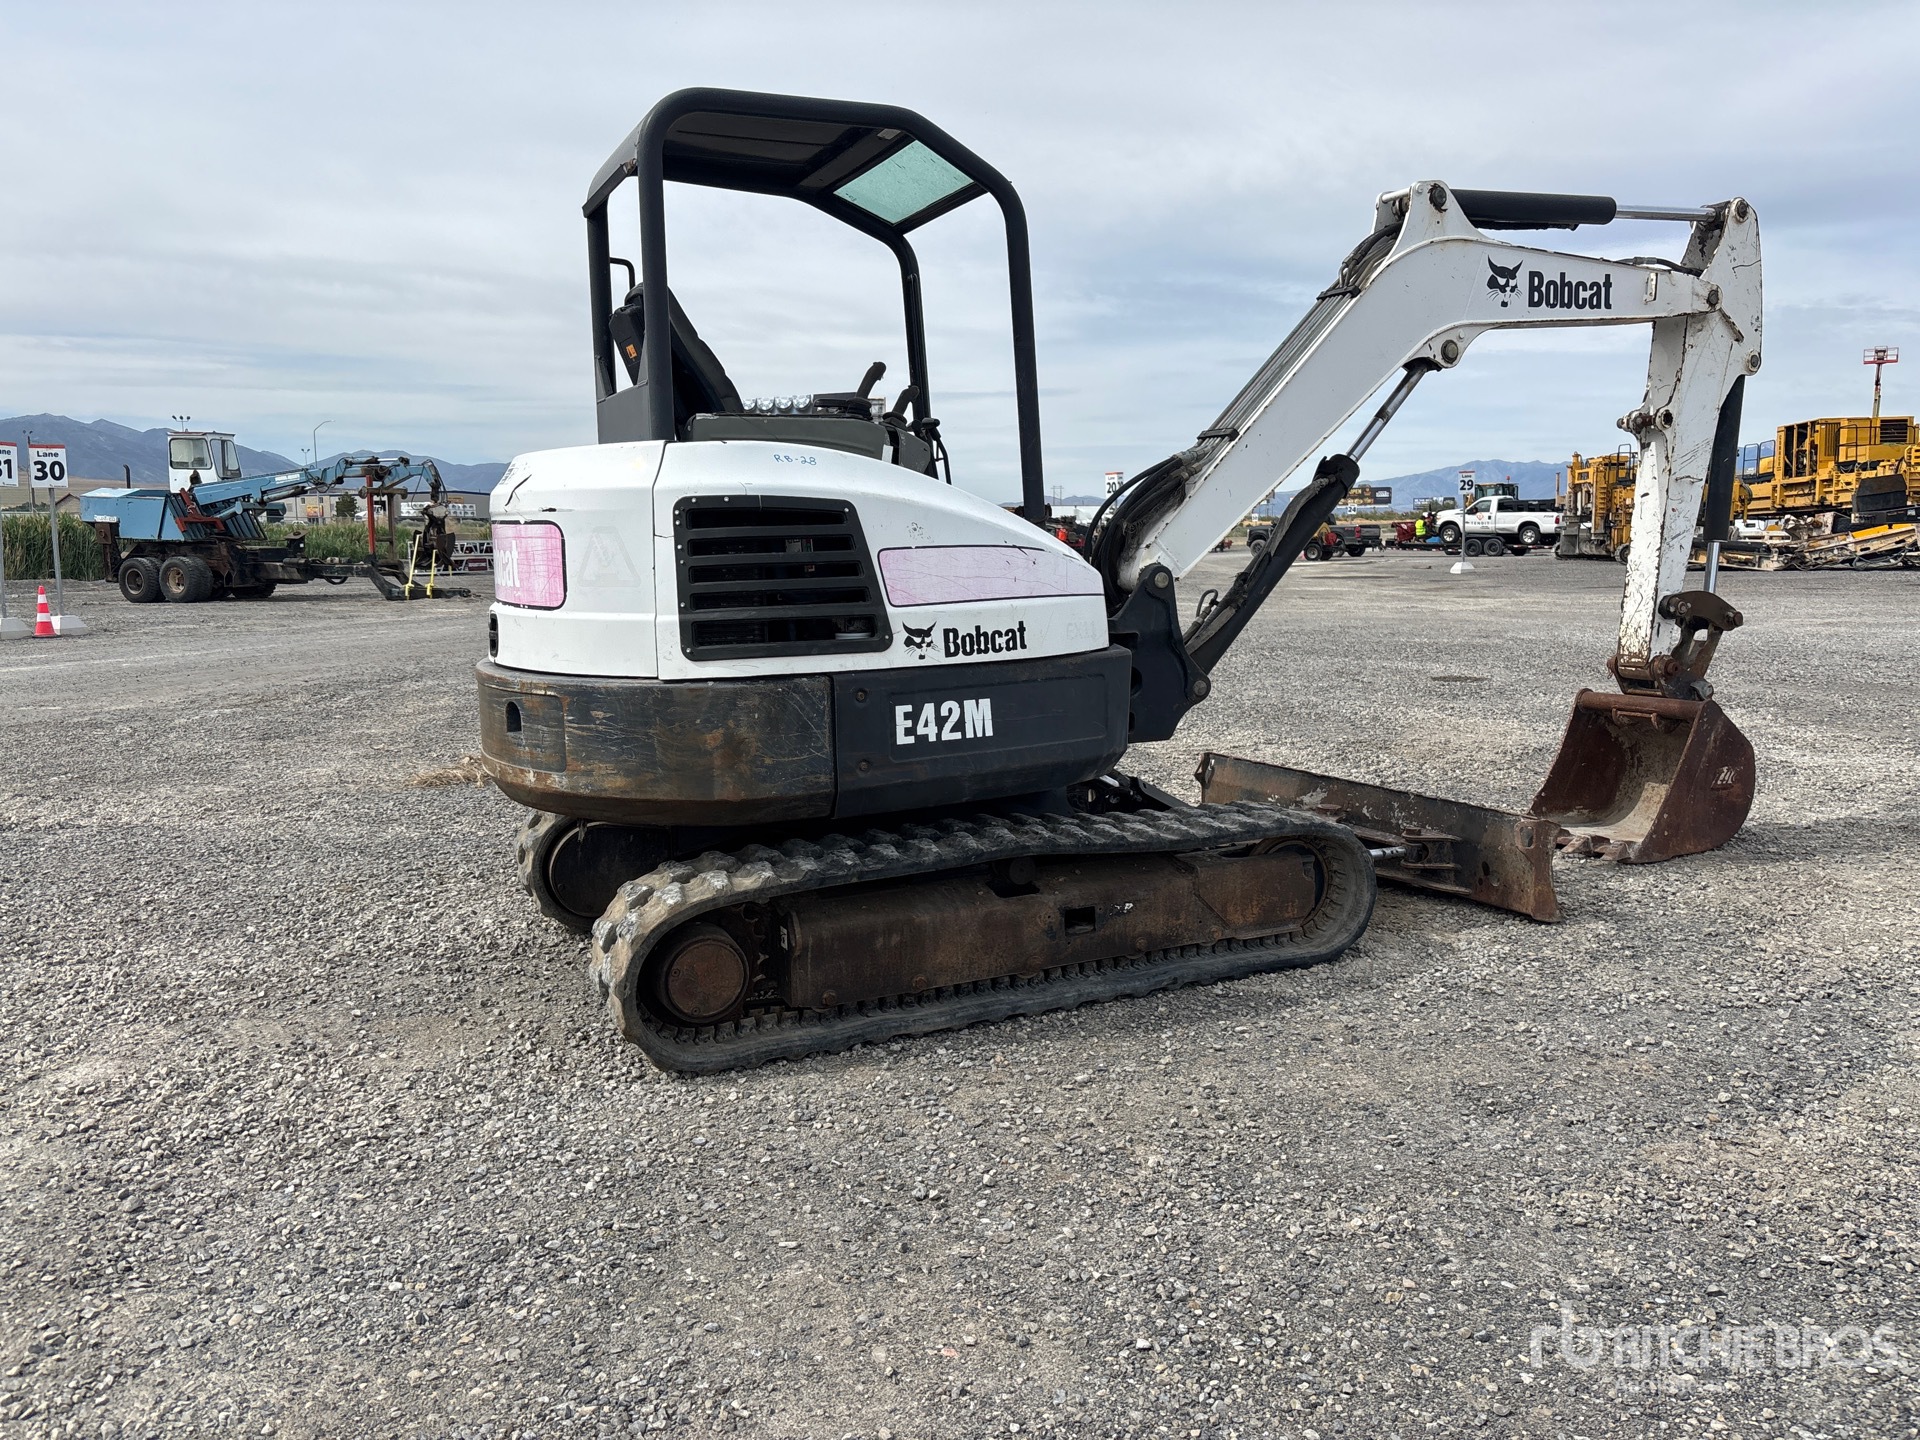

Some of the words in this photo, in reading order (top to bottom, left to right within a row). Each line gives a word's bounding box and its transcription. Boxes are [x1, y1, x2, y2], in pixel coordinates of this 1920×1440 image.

[1527, 270, 1613, 310] Bobcat
[36, 450, 59, 458] Lane
[33, 460, 65, 481] 30
[1106, 481, 1117, 494] 20
[1459, 479, 1474, 491] 29
[942, 620, 1028, 658] Bobcat
[894, 698, 994, 745] E42M
